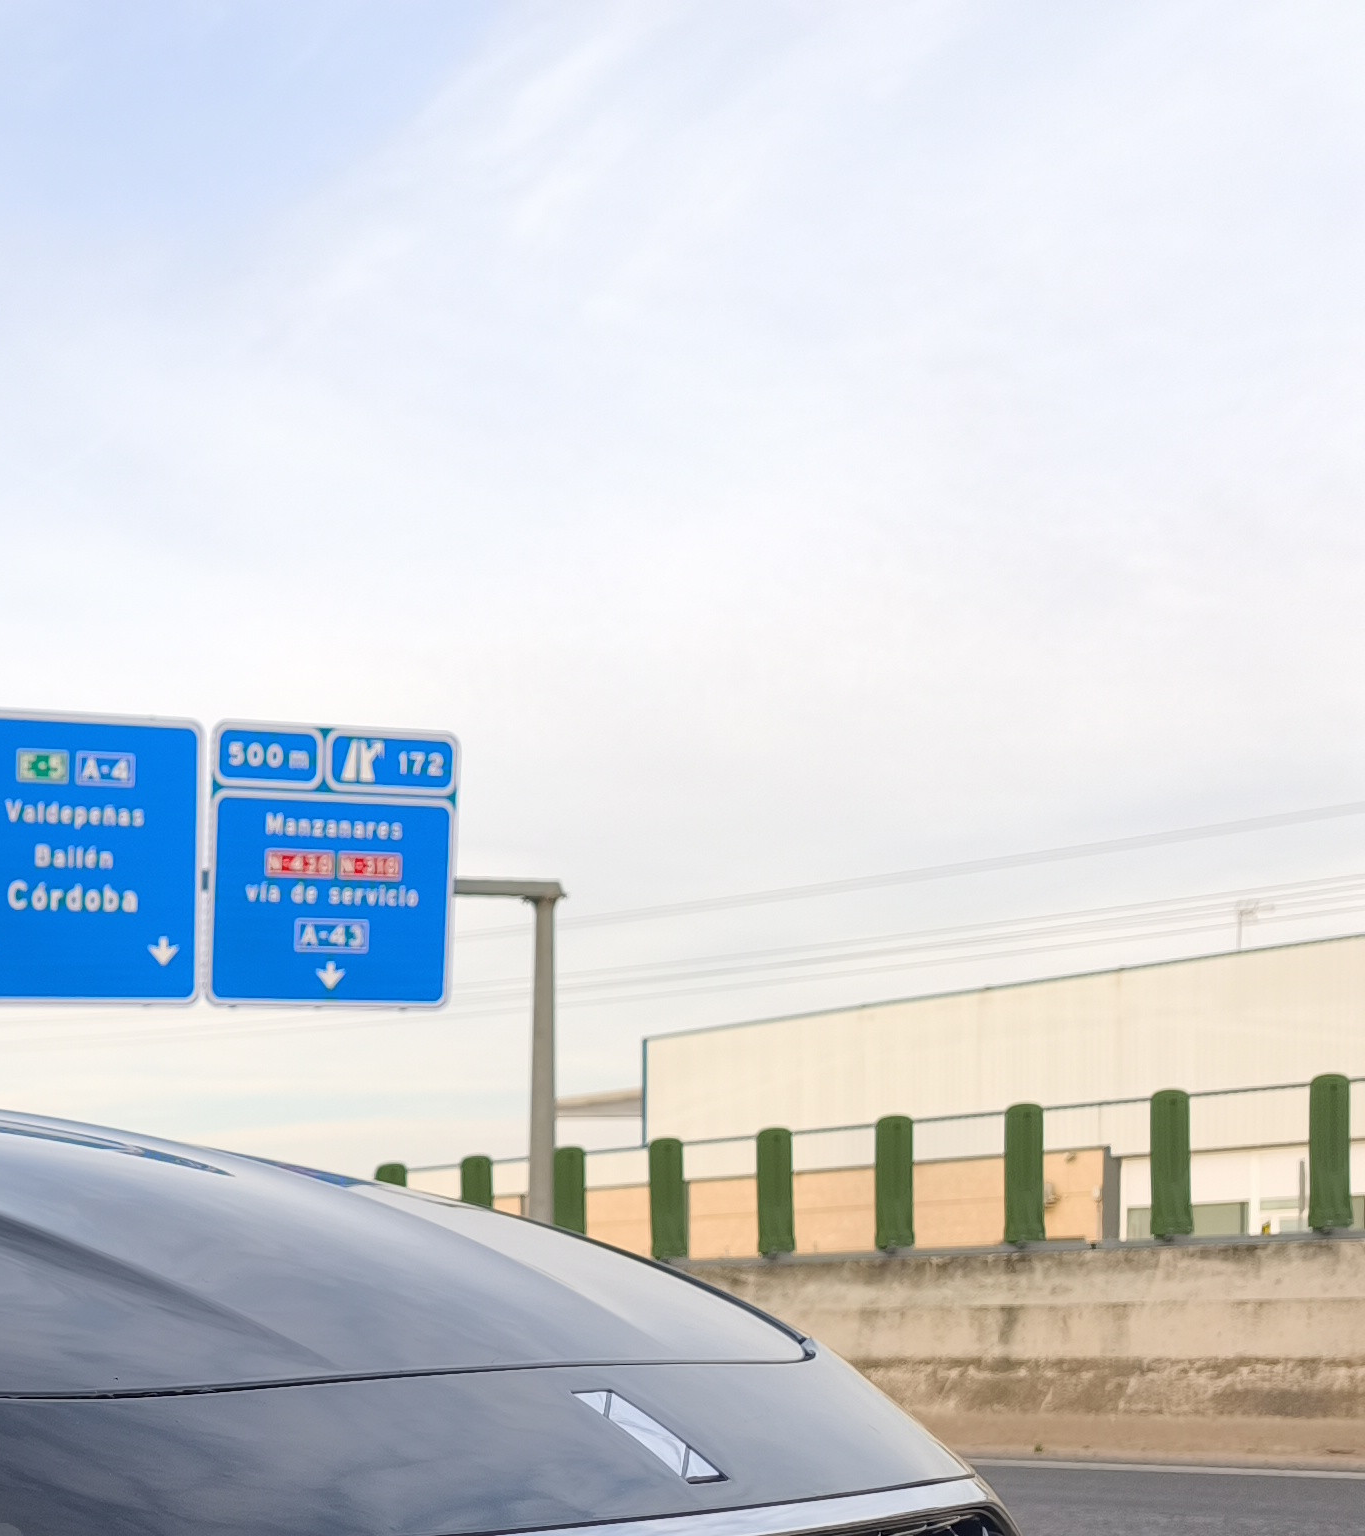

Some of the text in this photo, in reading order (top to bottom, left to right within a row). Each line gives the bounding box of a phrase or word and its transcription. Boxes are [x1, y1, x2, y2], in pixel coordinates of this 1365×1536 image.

[19, 754, 130, 782] E-5 A-4
[228, 741, 310, 770] 500 m
[398, 751, 444, 777] 172
[4, 798, 145, 830] Valdepeñas
[265, 812, 404, 841] Manzanares
[7, 879, 139, 914] Córdoba
[290, 881, 318, 905] de
[328, 884, 419, 908] servicio
[300, 923, 365, 948] A-43
